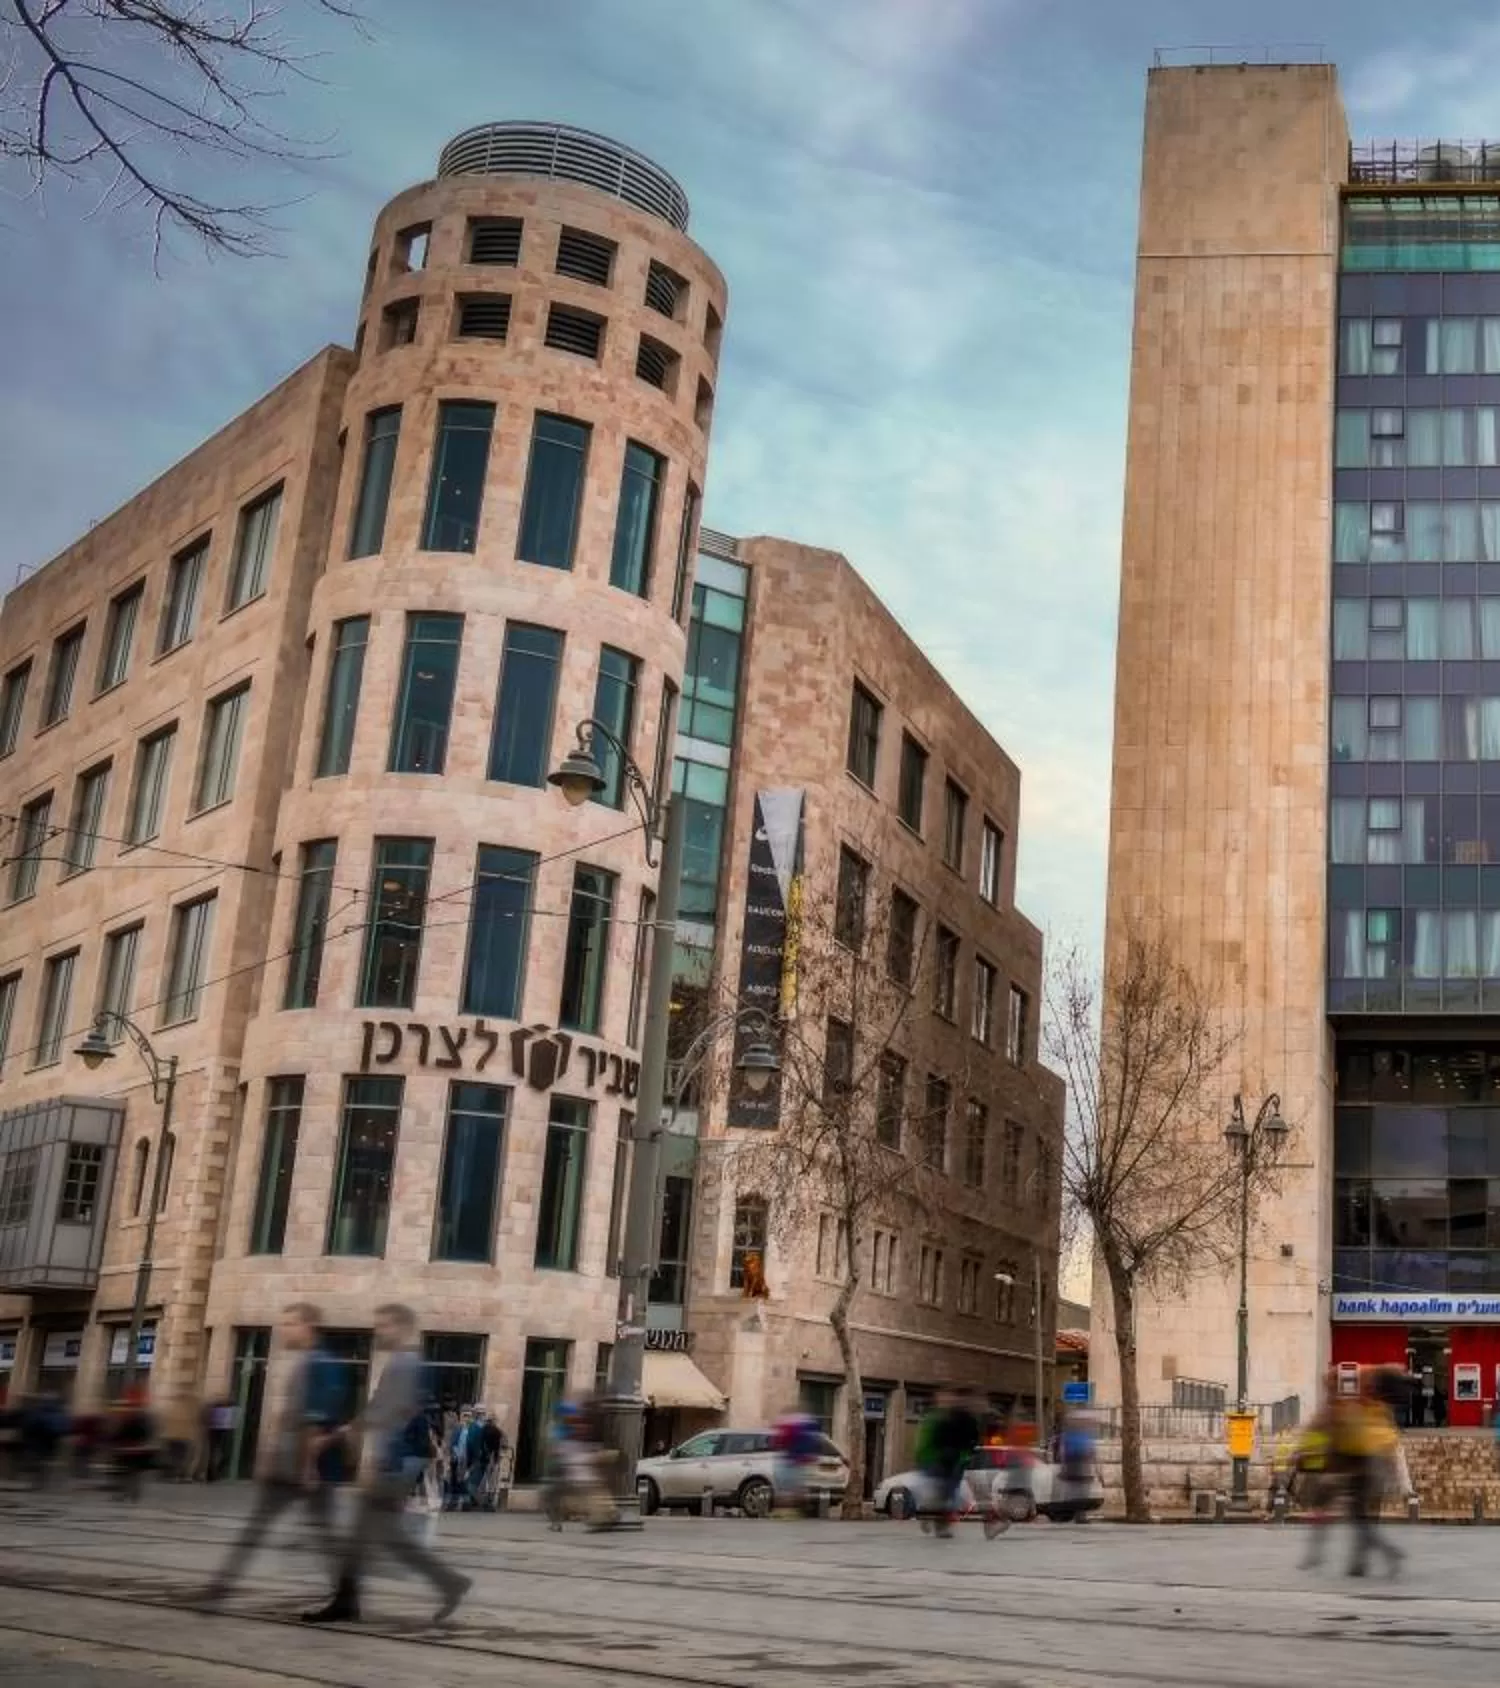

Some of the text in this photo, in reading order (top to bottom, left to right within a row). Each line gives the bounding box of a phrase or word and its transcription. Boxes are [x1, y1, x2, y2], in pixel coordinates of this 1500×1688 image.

[359, 1019, 641, 1099] שביר לצרכן
[1337, 1298, 1453, 1316] bank hapoalim
